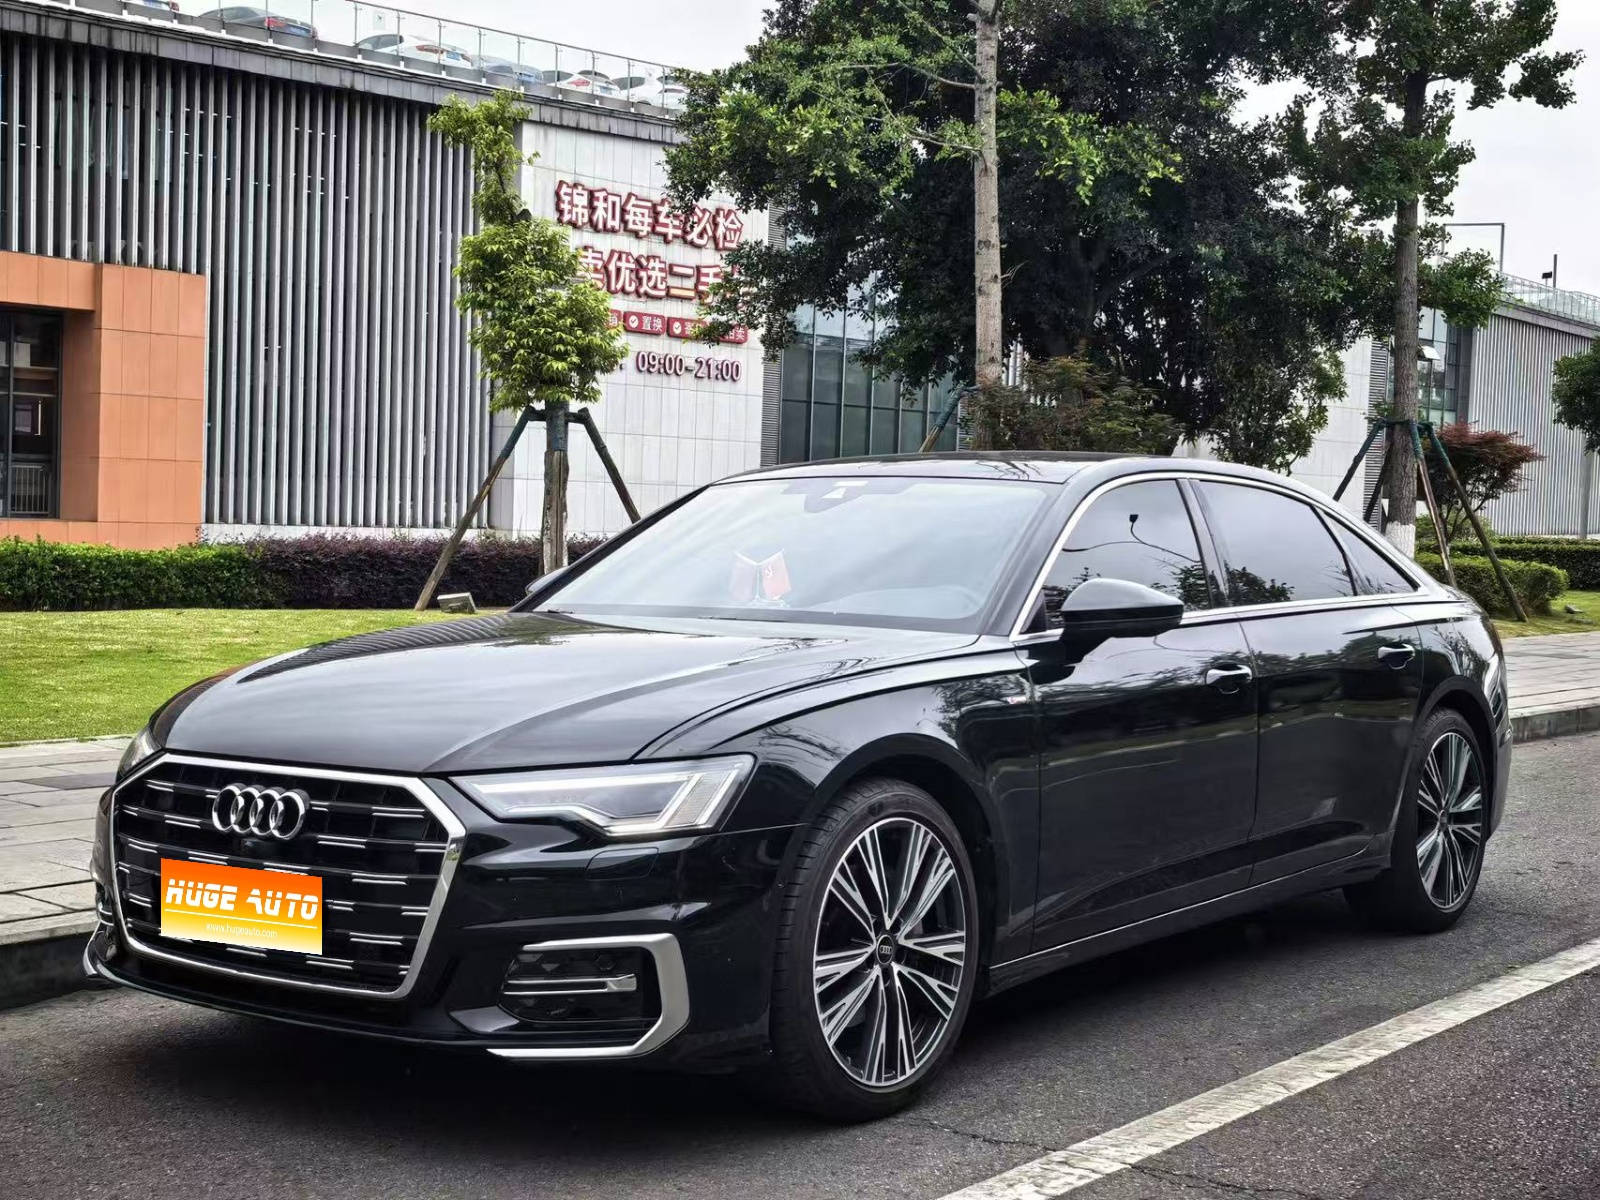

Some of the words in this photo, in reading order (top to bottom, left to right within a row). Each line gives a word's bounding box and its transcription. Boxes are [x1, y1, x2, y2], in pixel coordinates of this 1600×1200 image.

[556, 180, 744, 249] 锦和每车必检
[641, 315, 663, 333] 置换
[636, 351, 742, 381] 09:00-21:00
